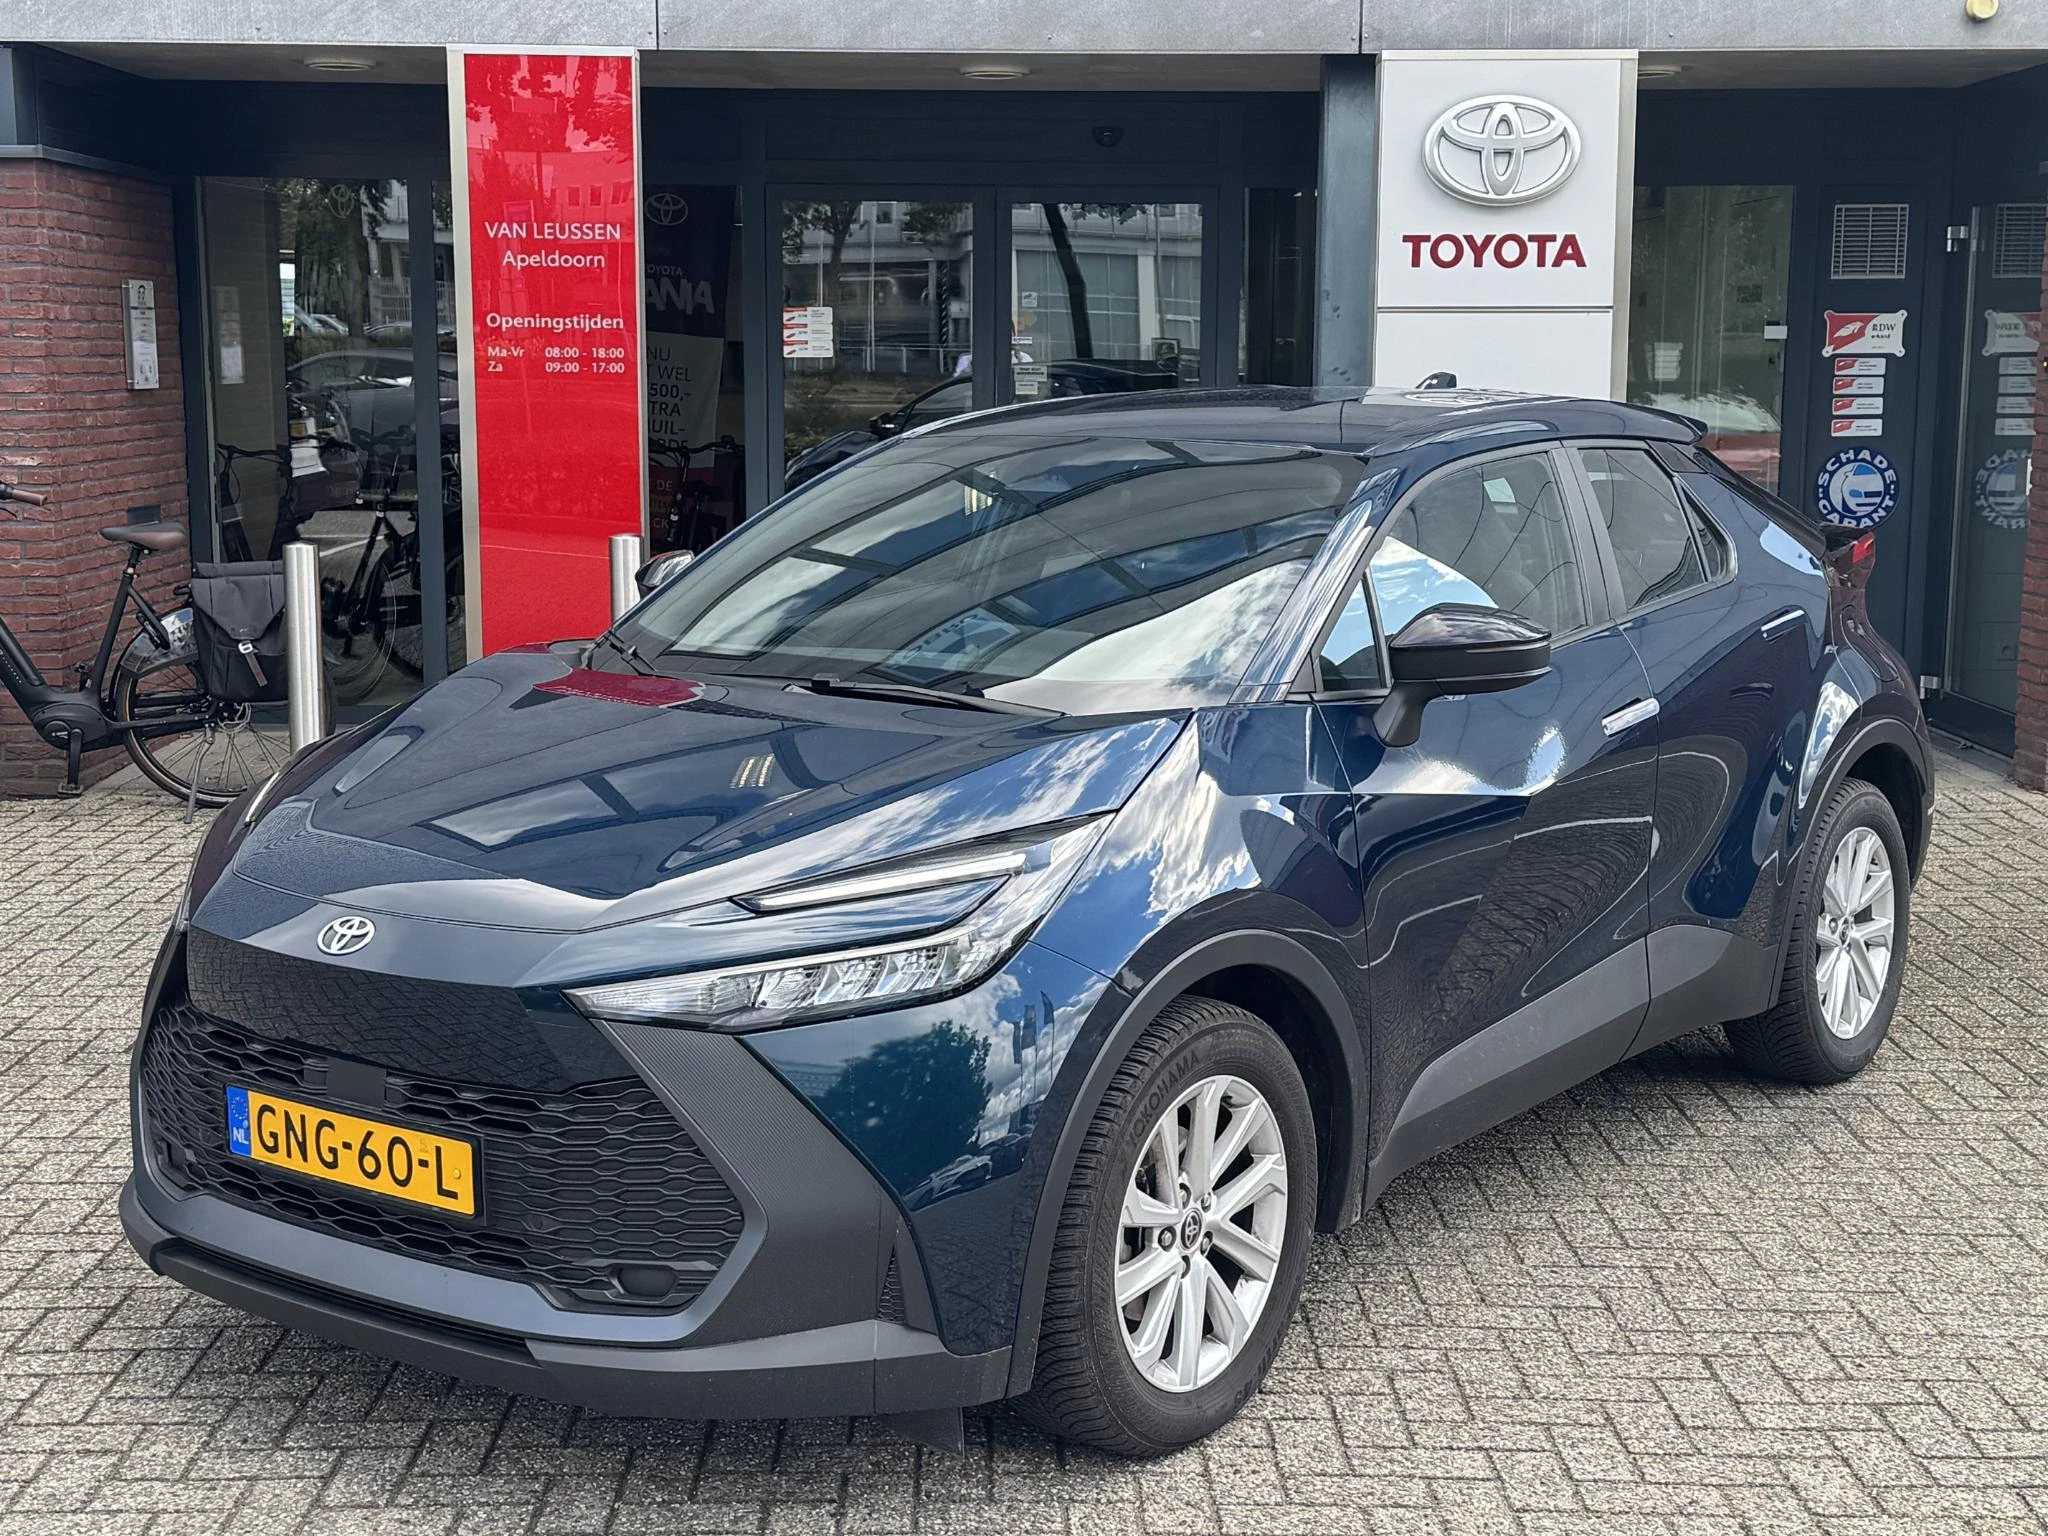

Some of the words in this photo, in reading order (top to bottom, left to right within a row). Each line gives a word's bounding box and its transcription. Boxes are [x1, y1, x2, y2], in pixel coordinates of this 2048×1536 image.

[485, 222, 526, 239] VAN
[533, 223, 621, 240] LEUSSEN
[1402, 233, 1587, 269] TOYOTA
[503, 250, 605, 271] Apeldoorn
[646, 263, 683, 276] OYOTA
[645, 276, 715, 315] ANIA
[486, 312, 624, 333] Openingstijden
[1871, 323, 1897, 332] RDW
[488, 347, 525, 358] Ma-Vr
[545, 347, 579, 358] 08:00
[592, 347, 625, 359] 18:00
[488, 361, 503, 372] Za
[545, 362, 580, 373] 09:00
[592, 362, 625, 373] 17:00
[657, 364, 693, 382] WEL
[649, 401, 681, 417] TRA
[648, 419, 686, 435] UIL-
[1818, 449, 1897, 486] SCHADE
[1129, 1050, 1200, 1148] YOKOHAMA
[233, 1126, 249, 1145] NL
[257, 1103, 459, 1200] GNG-60-L
